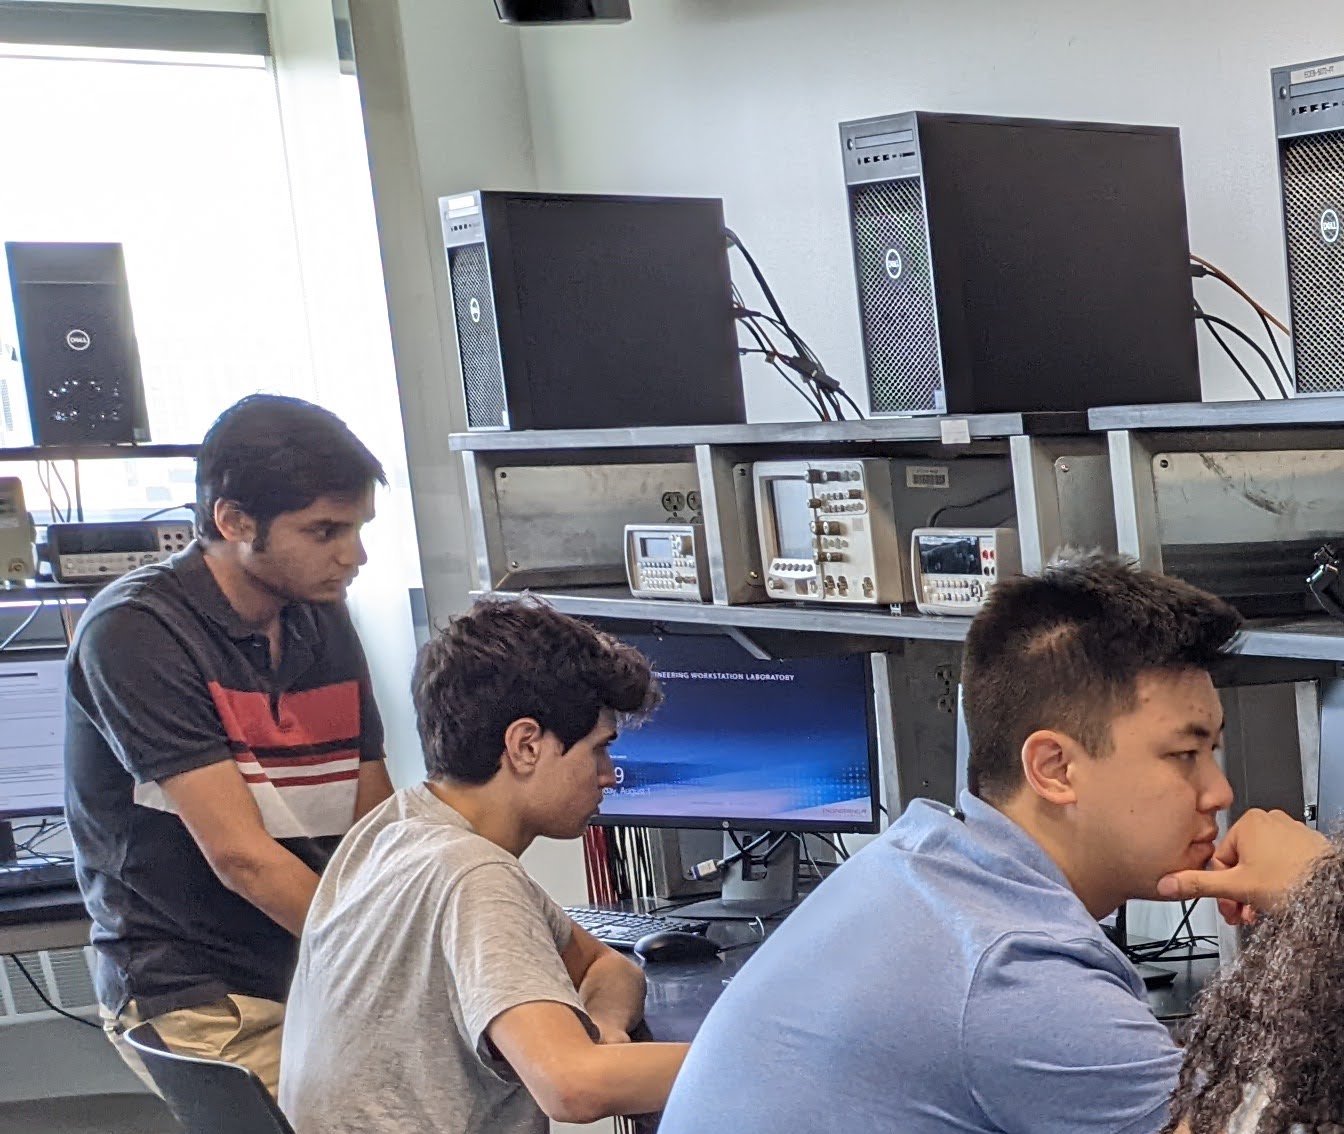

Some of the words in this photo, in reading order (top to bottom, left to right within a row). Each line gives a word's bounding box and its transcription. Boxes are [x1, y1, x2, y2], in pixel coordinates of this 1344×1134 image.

[653, 671, 690, 680] INEERING
[691, 672, 744, 680] WORKSTATION
[745, 673, 795, 682] LABORATORY
